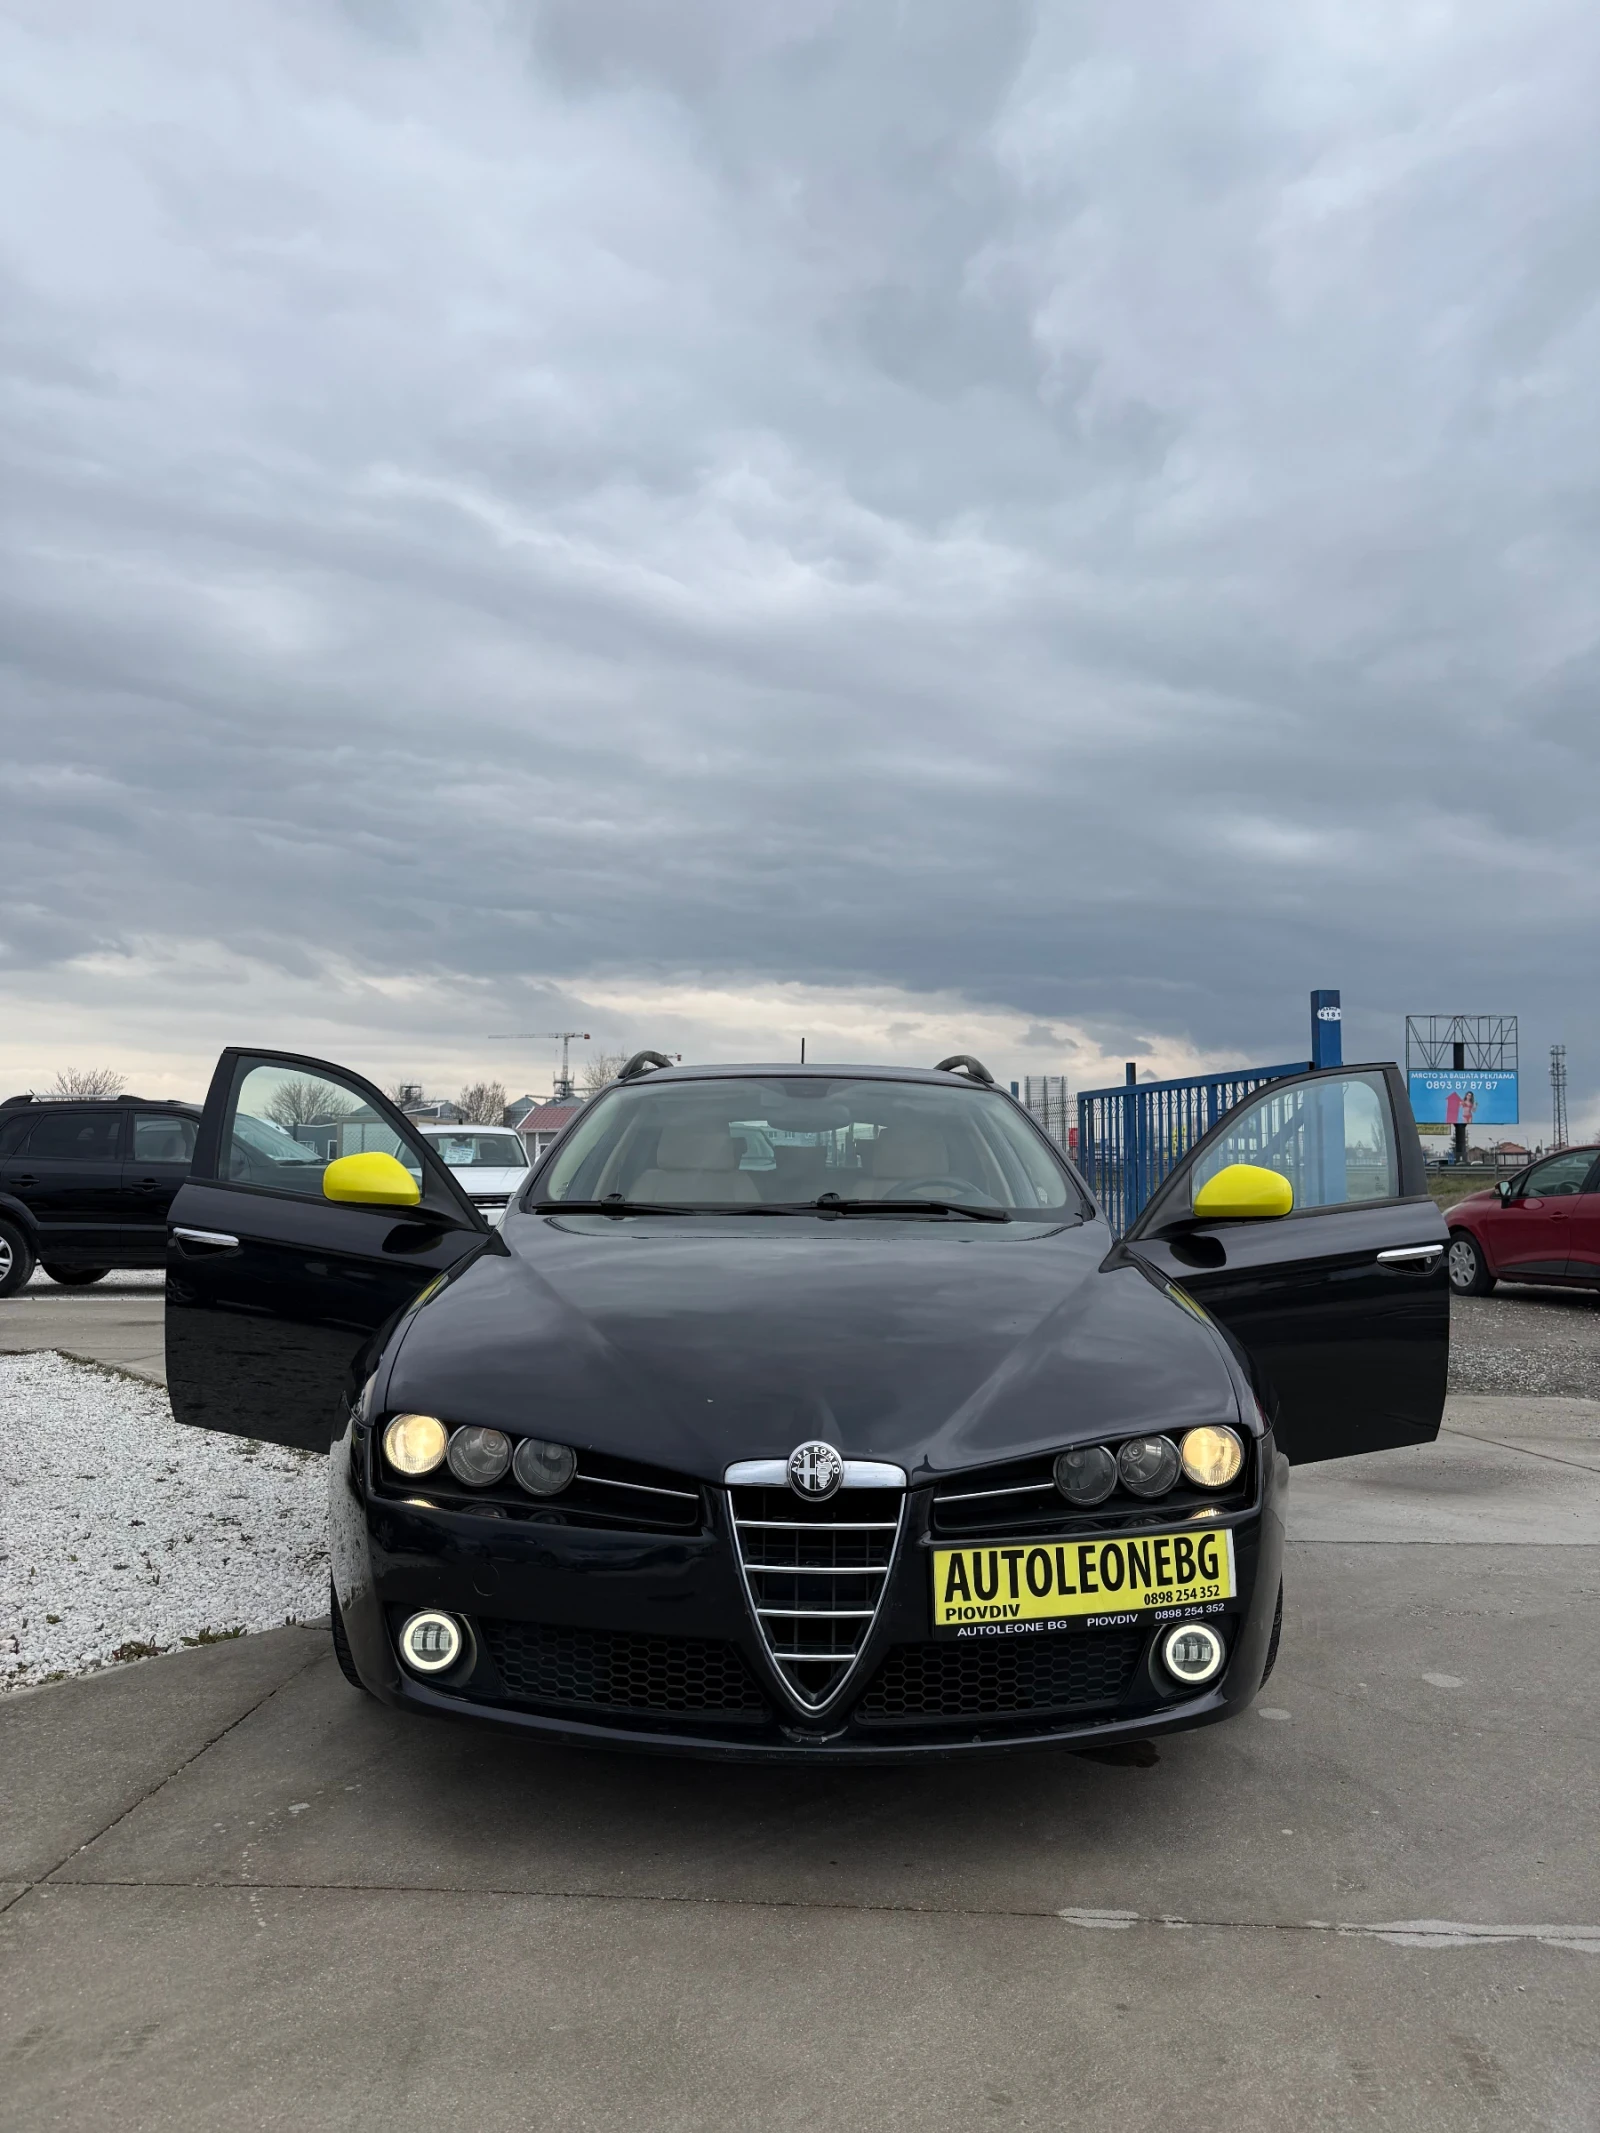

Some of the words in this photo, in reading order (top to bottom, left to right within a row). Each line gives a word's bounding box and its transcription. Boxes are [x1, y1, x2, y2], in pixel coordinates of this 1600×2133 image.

[1426, 1081, 1452, 1090] 0893
[1455, 1081, 1467, 1090] 87
[1470, 1081, 1482, 1090] 87
[1485, 1081, 1498, 1090] 87
[791, 1449, 810, 1473] ALFA
[813, 1446, 840, 1474] ROMEO
[944, 1533, 1220, 1603] AUTOLEONEBG
[1144, 1590, 1173, 1606] 0898
[1175, 1587, 1197, 1602] 254
[1199, 1584, 1220, 1599] 352
[945, 1603, 1021, 1621] PIOVDIV
[957, 1621, 1044, 1637] AUTOLEONE
[1047, 1620, 1068, 1631] BG
[1086, 1613, 1139, 1627] PIOVDIV
[1155, 1608, 1182, 1620] 0898
[1184, 1605, 1204, 1617] 254
[1205, 1602, 1225, 1614] 352
